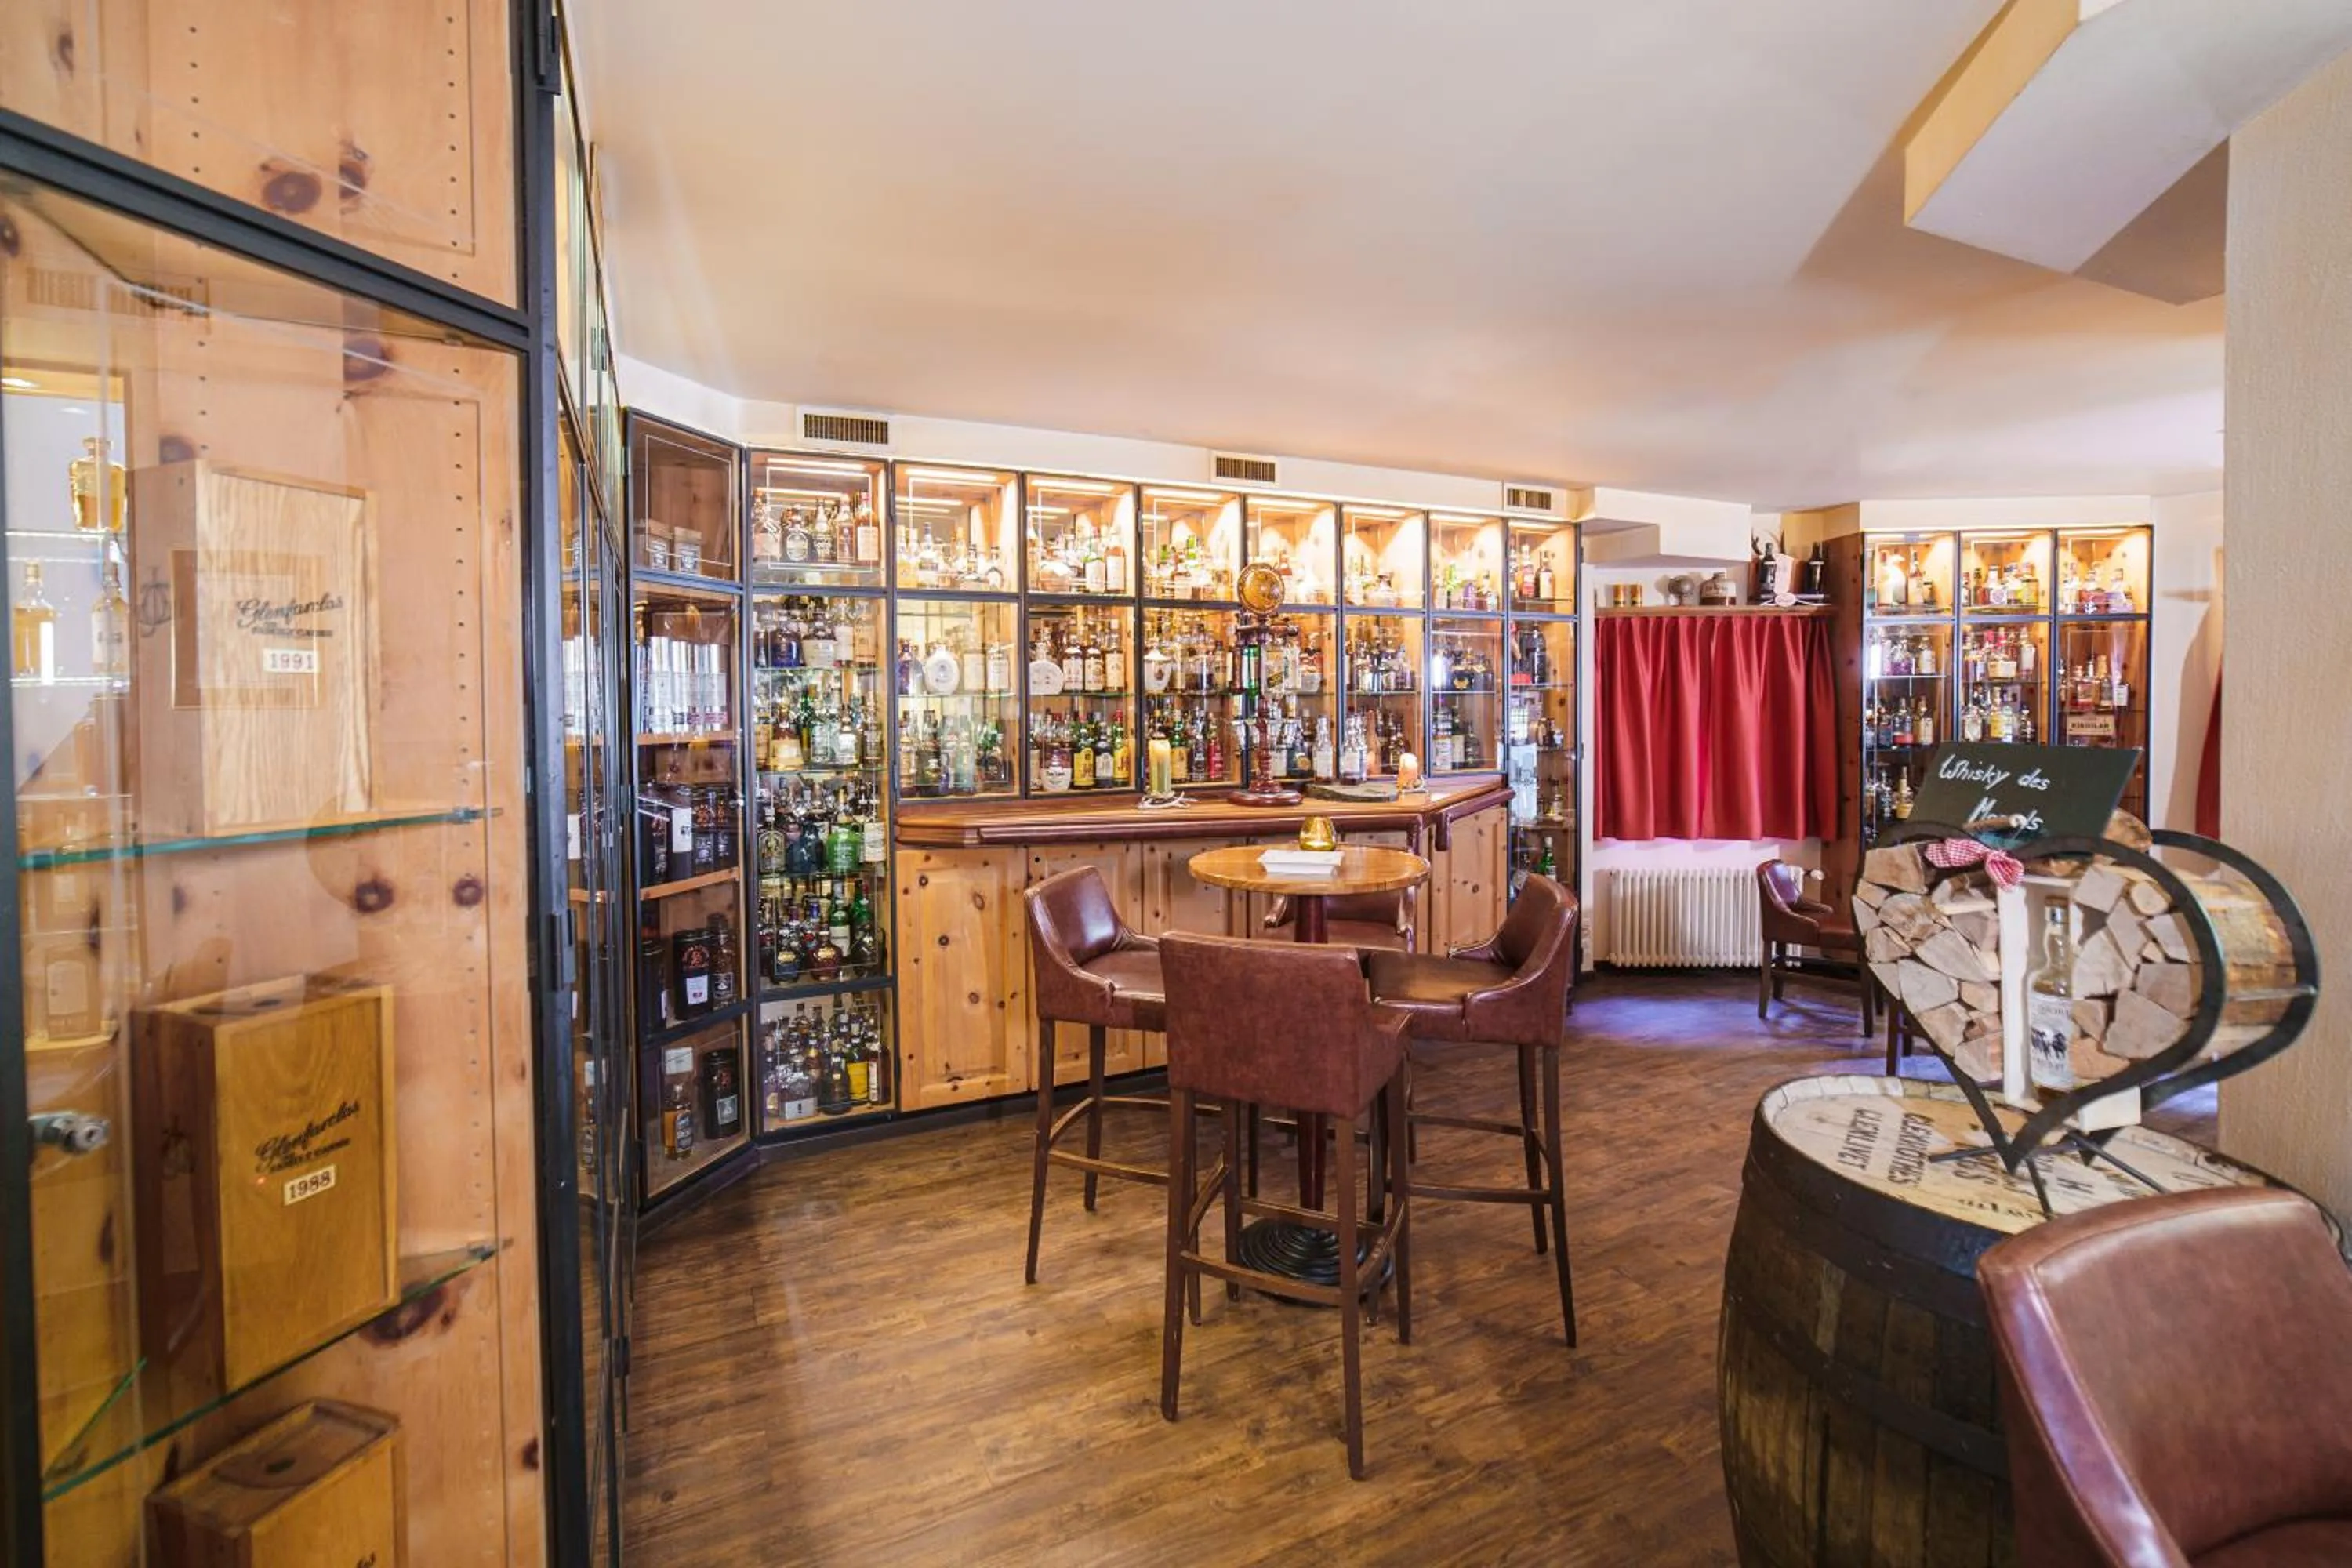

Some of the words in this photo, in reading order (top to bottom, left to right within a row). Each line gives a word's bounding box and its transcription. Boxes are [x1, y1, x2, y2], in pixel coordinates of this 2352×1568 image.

[270, 652, 314, 670] 1991
[1938, 753, 2010, 791] Whisky
[2017, 768, 2052, 791] des
[289, 1171, 331, 1199] 1988
